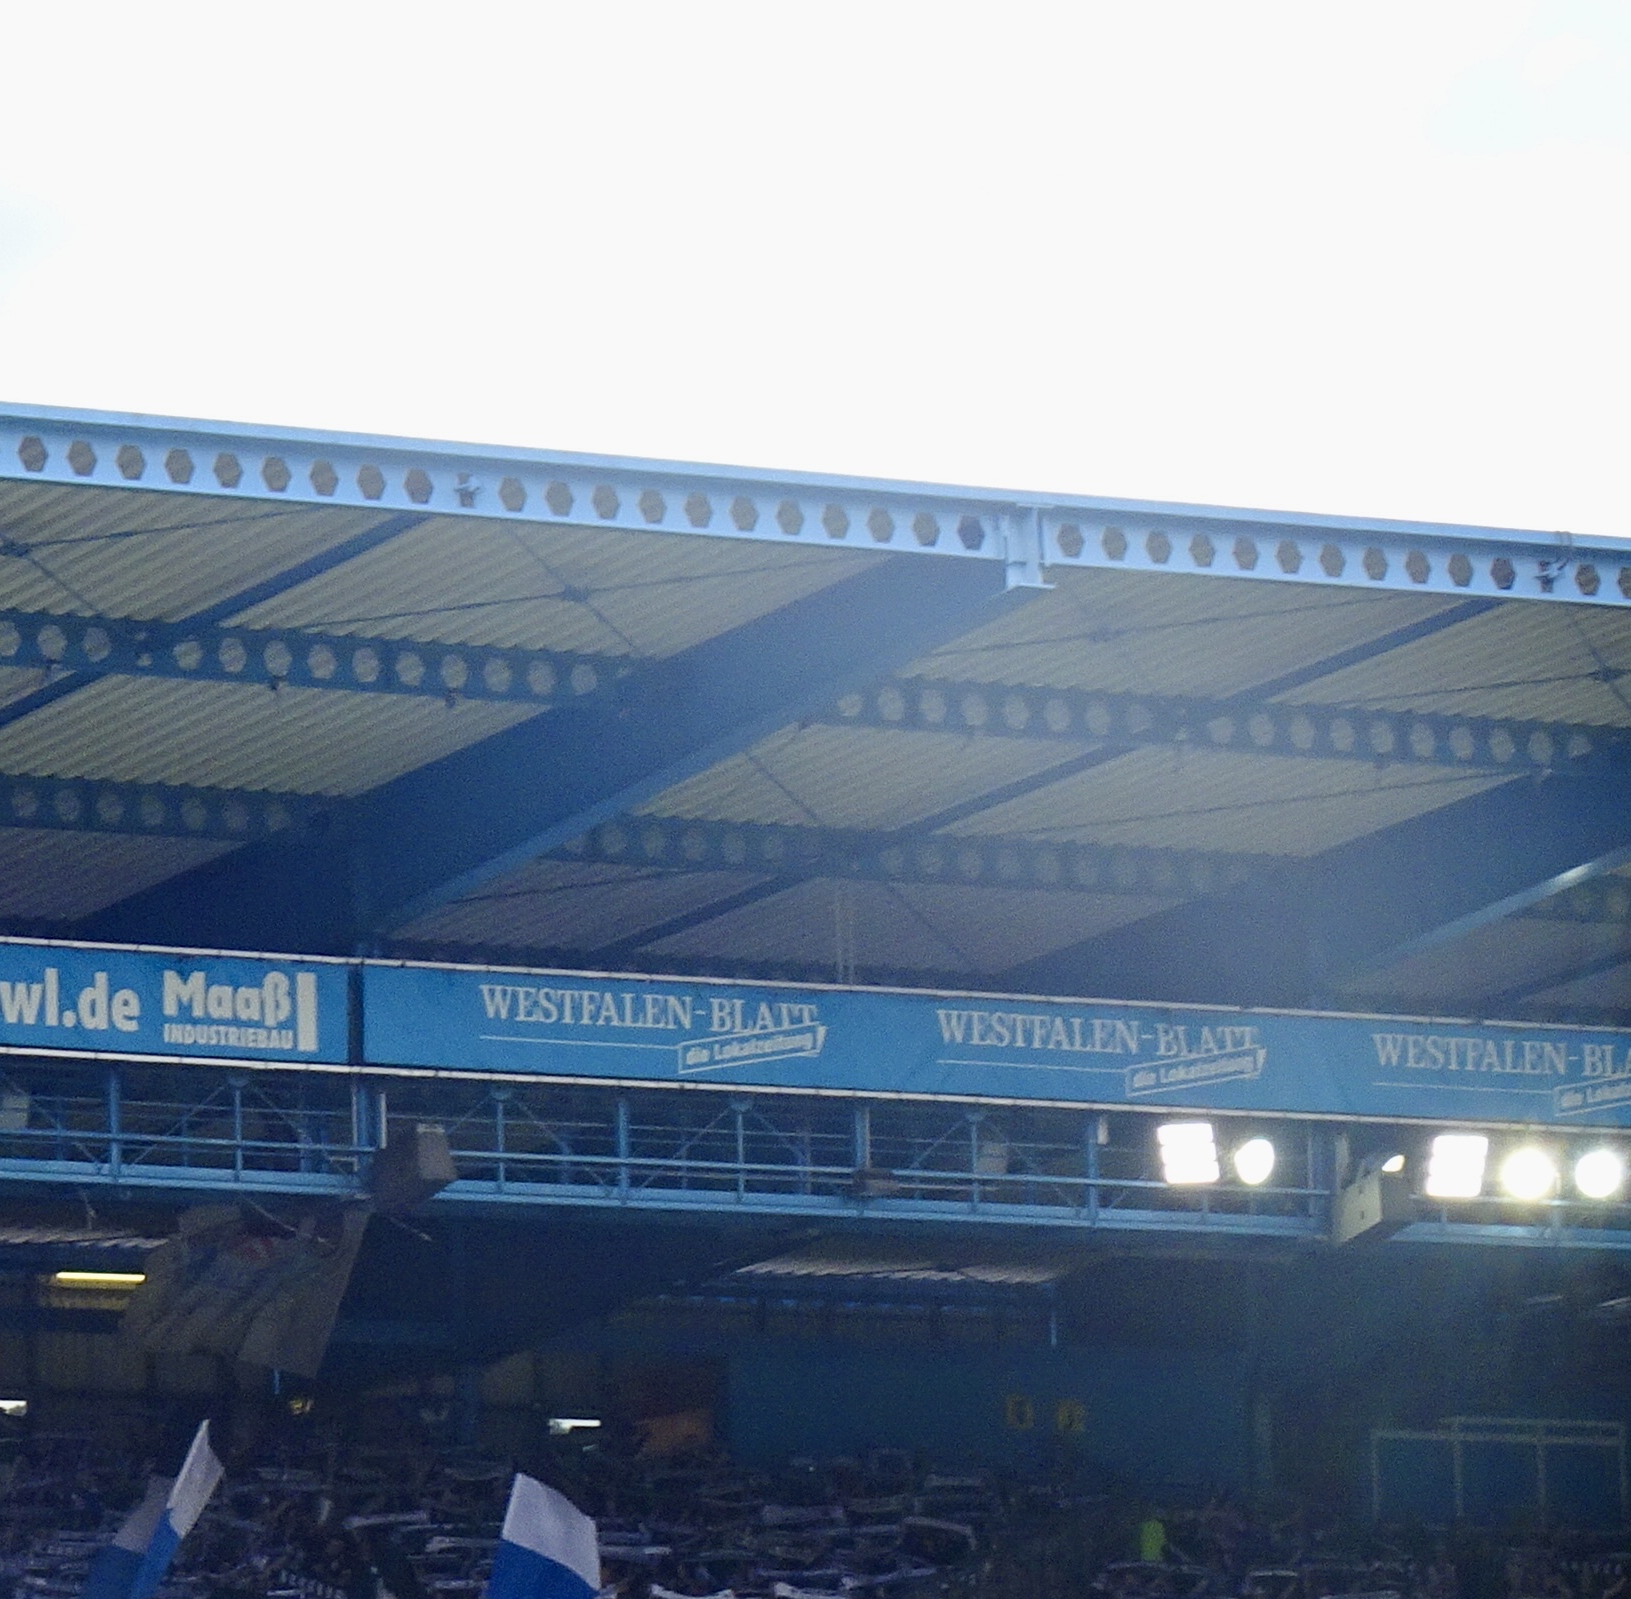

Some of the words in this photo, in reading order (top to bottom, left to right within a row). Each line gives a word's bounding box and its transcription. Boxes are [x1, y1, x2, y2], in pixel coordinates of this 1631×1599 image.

[162, 969, 293, 1027] Maaß
[479, 983, 819, 1034] WESTFALEN-BLATT
[163, 1022, 294, 1050] INDUSTRIEBAU
[937, 1007, 1261, 1055] WESTFALEN-BLATT
